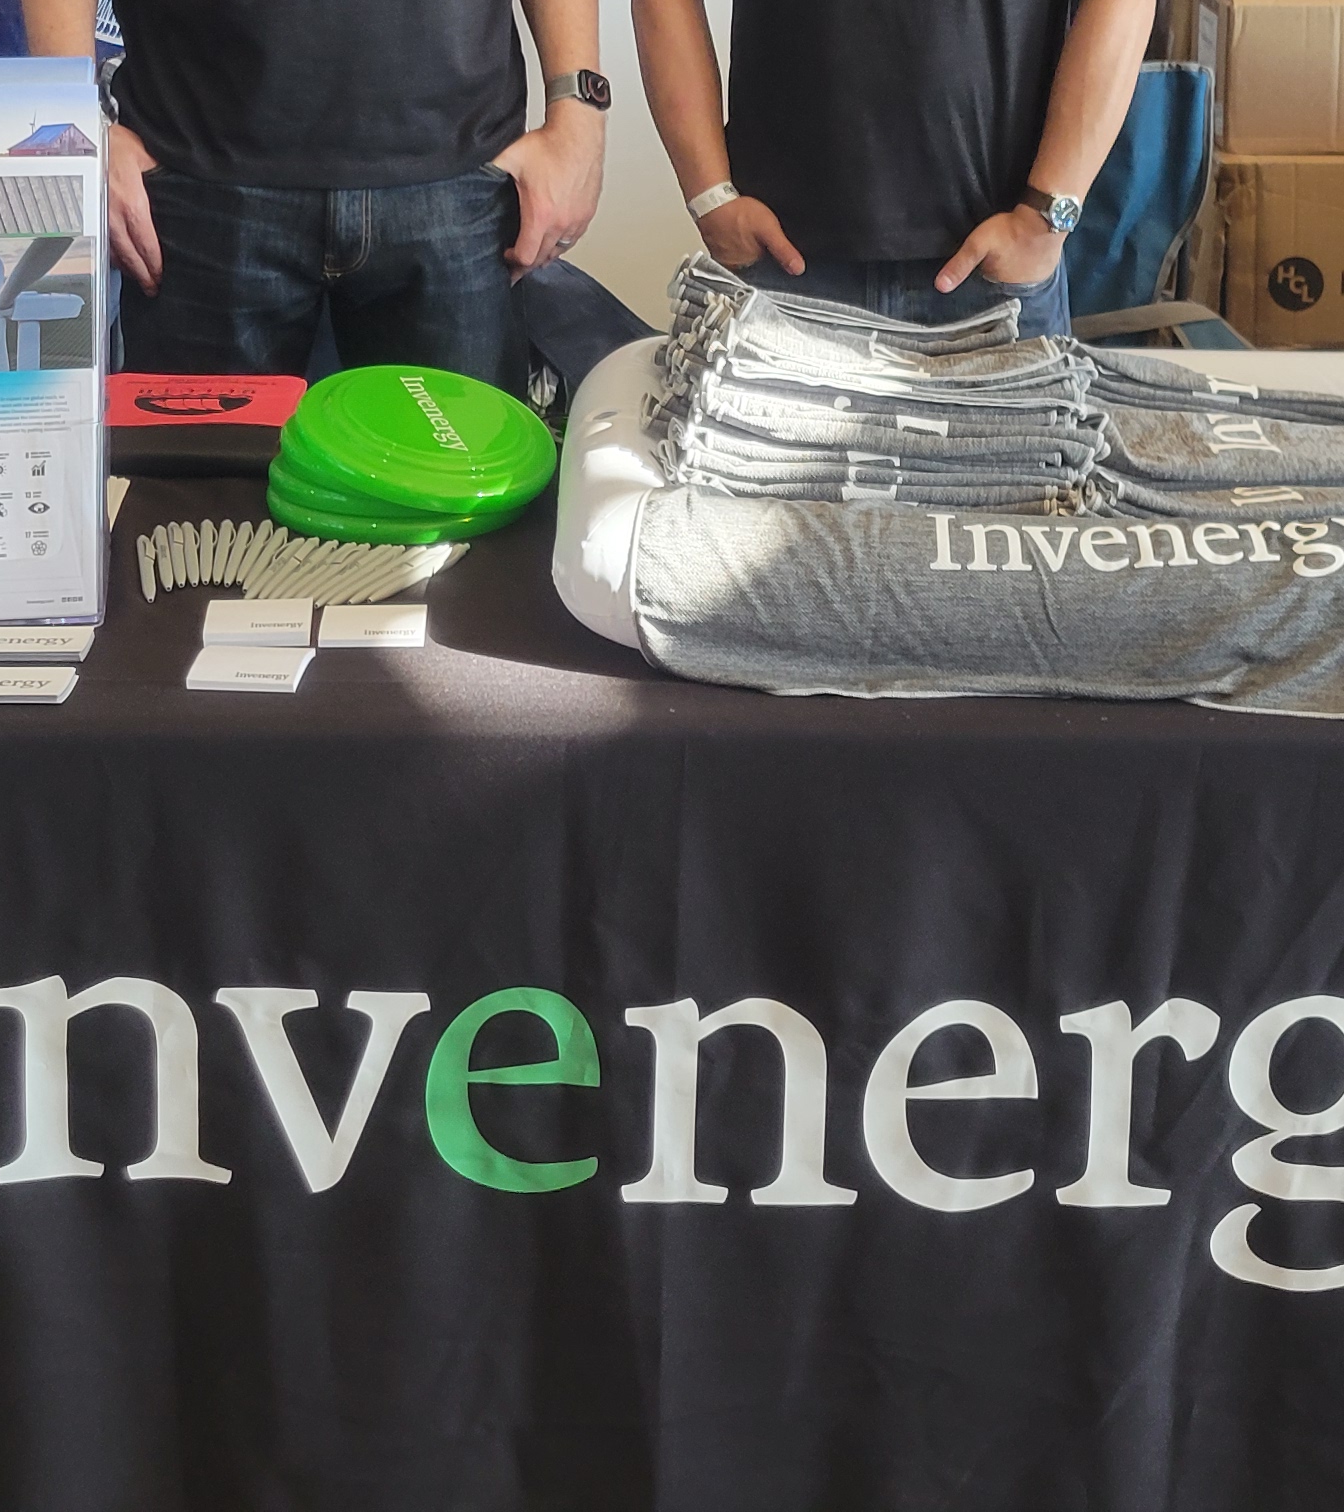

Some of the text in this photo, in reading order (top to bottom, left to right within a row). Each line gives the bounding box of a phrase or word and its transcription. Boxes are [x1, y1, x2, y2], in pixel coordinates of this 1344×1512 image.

[1276, 265, 1315, 304] HCL
[399, 375, 469, 453] Invenergy
[250, 620, 304, 631] Invenergy
[363, 627, 417, 637] Invenergy
[235, 670, 291, 681] Invenergy
